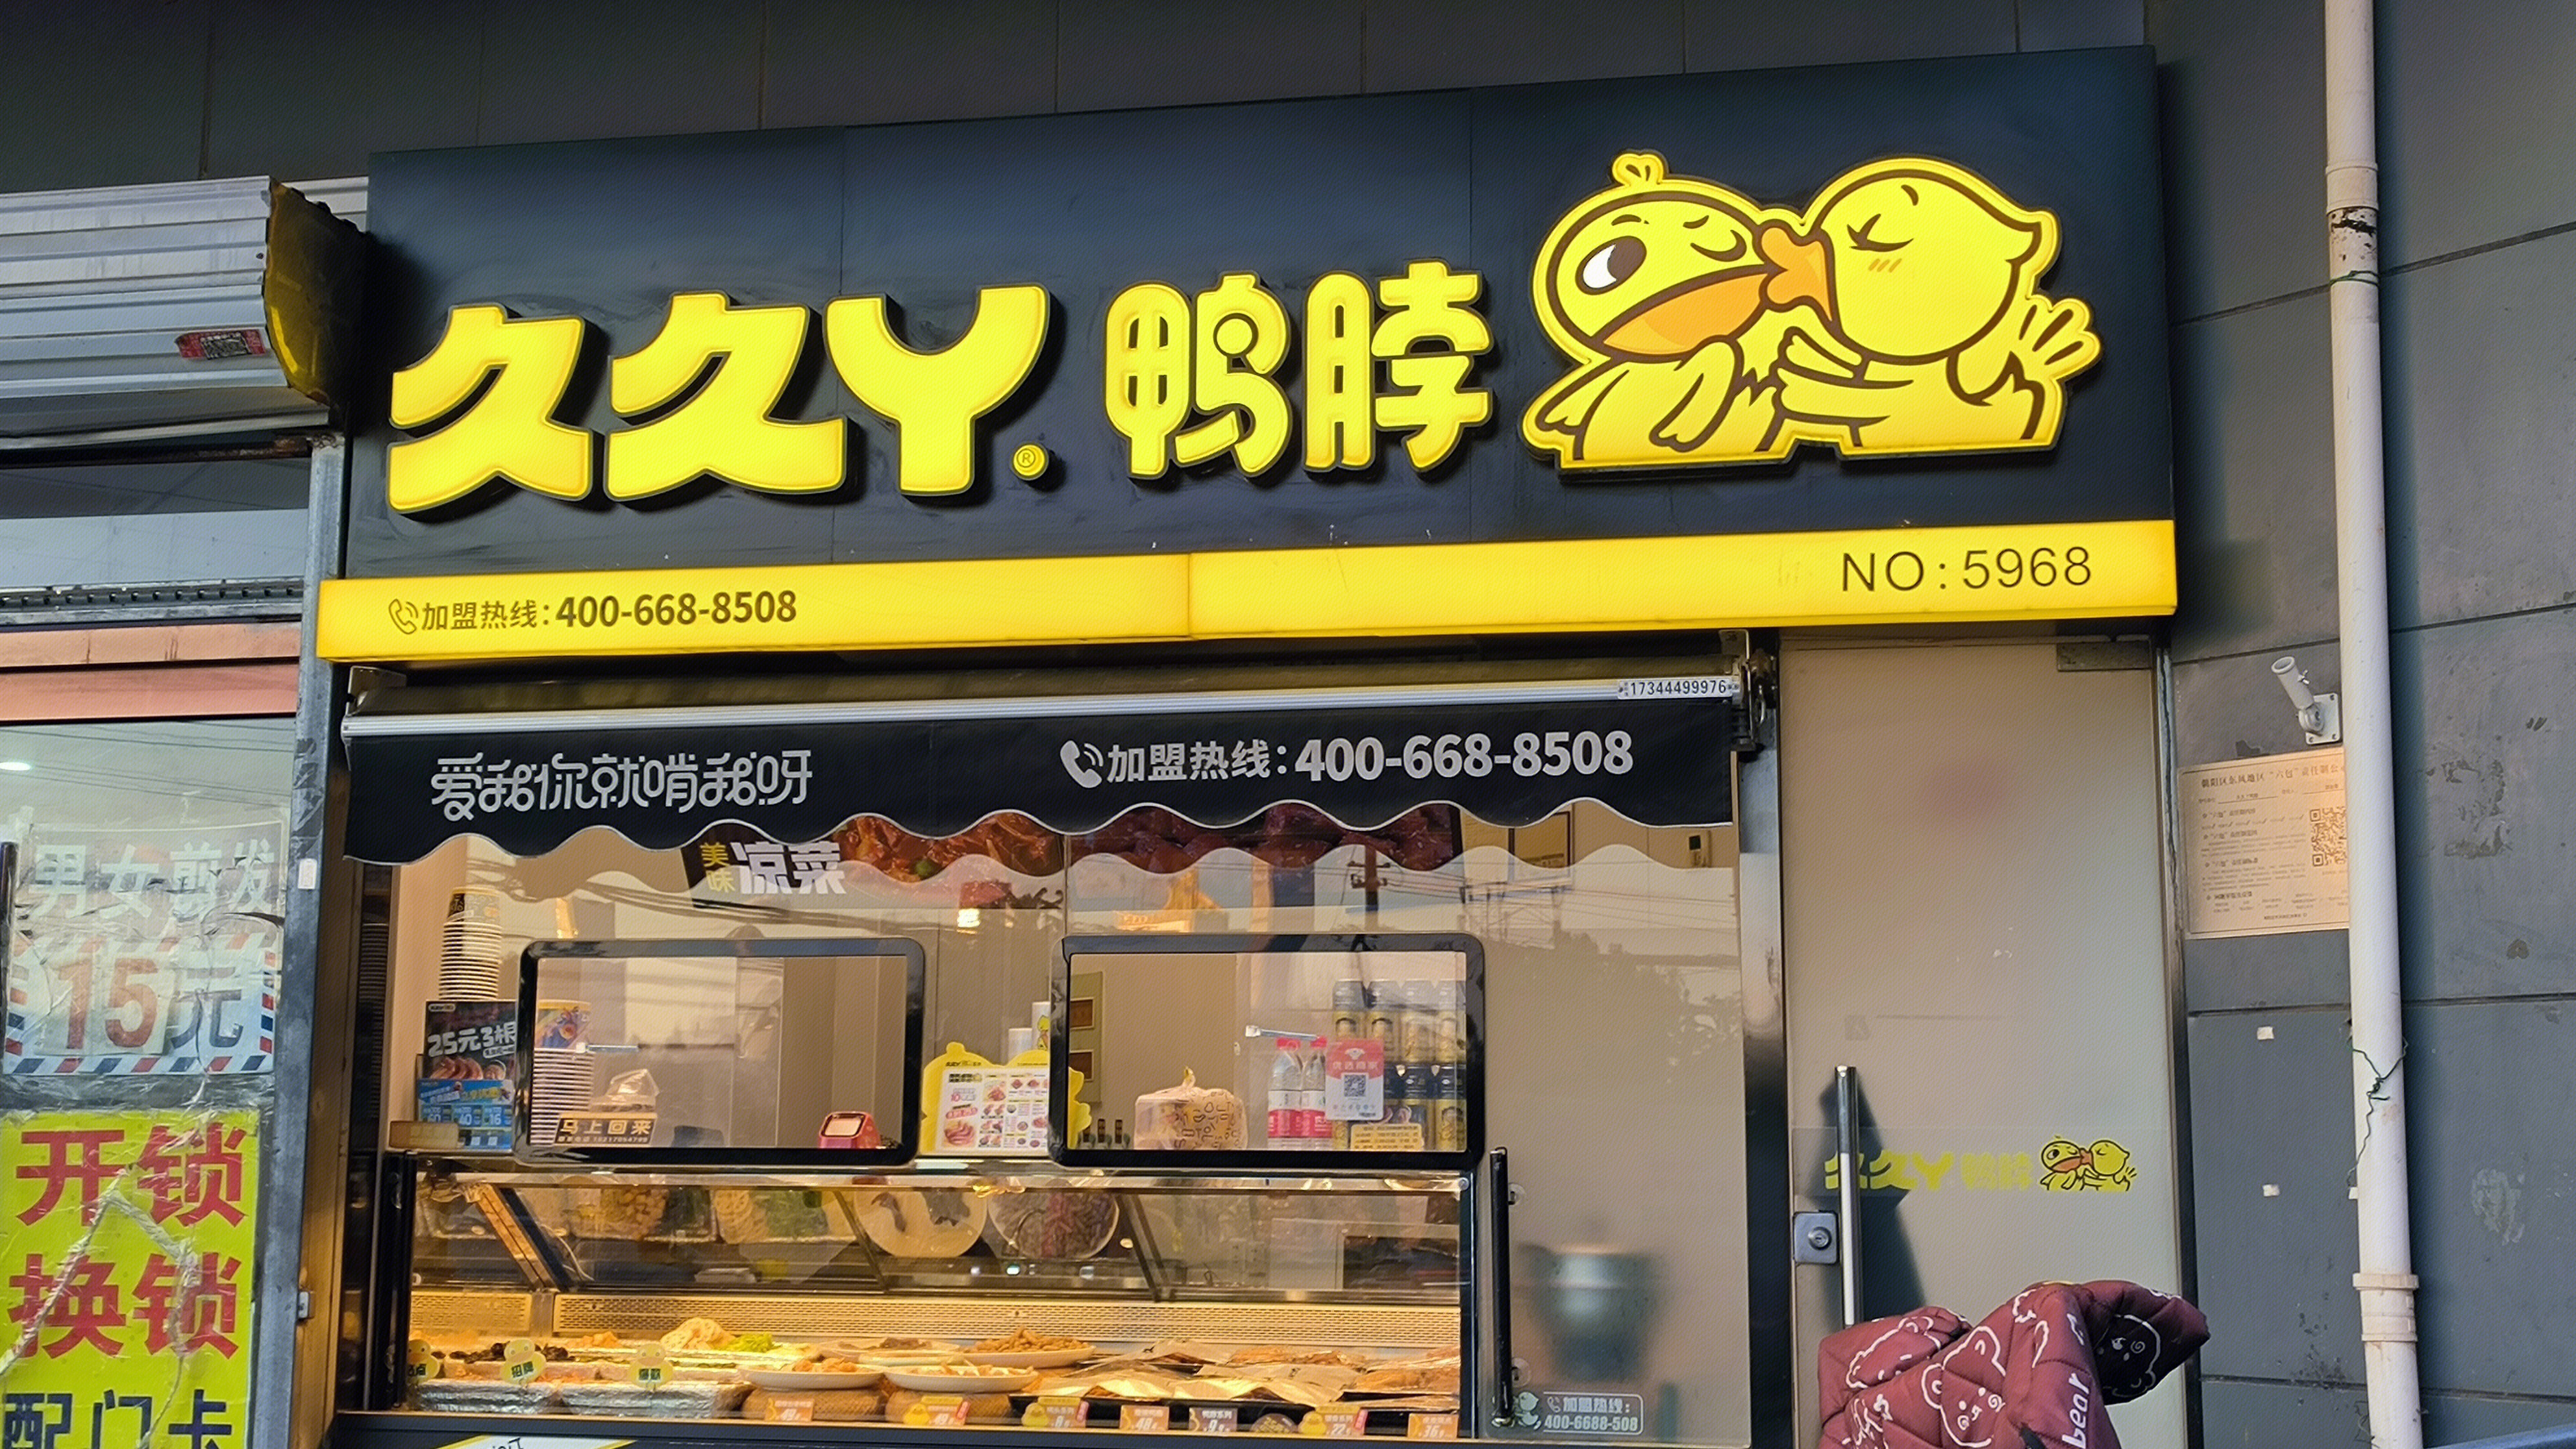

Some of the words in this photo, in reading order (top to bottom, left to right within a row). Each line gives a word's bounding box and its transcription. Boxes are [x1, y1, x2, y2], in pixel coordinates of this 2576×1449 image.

[1106, 260, 1493, 478] 鸭脖
[1630, 680, 1726, 695] 17344499976
[431, 749, 813, 822] 爱我你就啃我呀
[29, 837, 275, 922] 男女剪发
[700, 842, 735, 893] 美味
[730, 841, 847, 894] 凉菜
[58, 958, 244, 1050] 15元
[427, 1021, 516, 1058] 25元3根
[560, 1119, 651, 1135] 马上回来
[16, 1122, 247, 1227] 开锁
[6, 1252, 242, 1359] 换锁
[5, 1389, 232, 1449] 配门卡
[1544, 1415, 1638, 1431] 400-6688-508
[2062, 1372, 2090, 1449] bear
